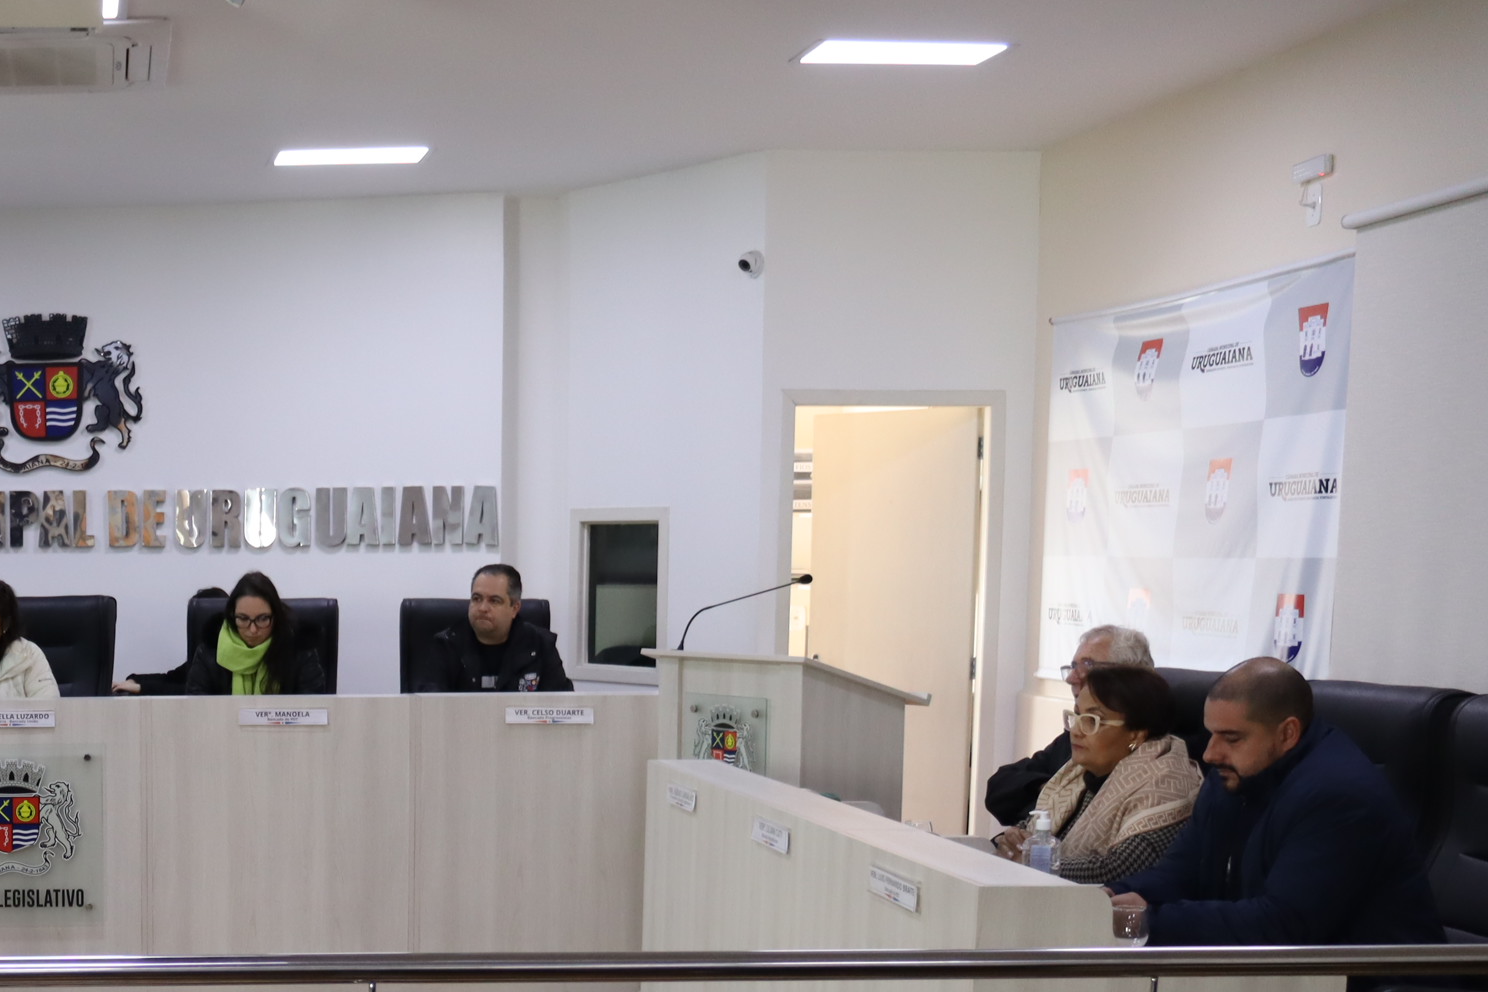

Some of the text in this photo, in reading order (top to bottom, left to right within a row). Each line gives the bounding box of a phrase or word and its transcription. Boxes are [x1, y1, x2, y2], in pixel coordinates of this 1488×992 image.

[1191, 346, 1253, 373] URUGUAIANA
[1060, 372, 1106, 393] URUGUAIANA
[1114, 489, 1170, 508] URUGUAIANA
[1269, 478, 1338, 501] URUGUAIANA
[107, 489, 168, 548] DE
[175, 485, 500, 549] URUGUAIANA
